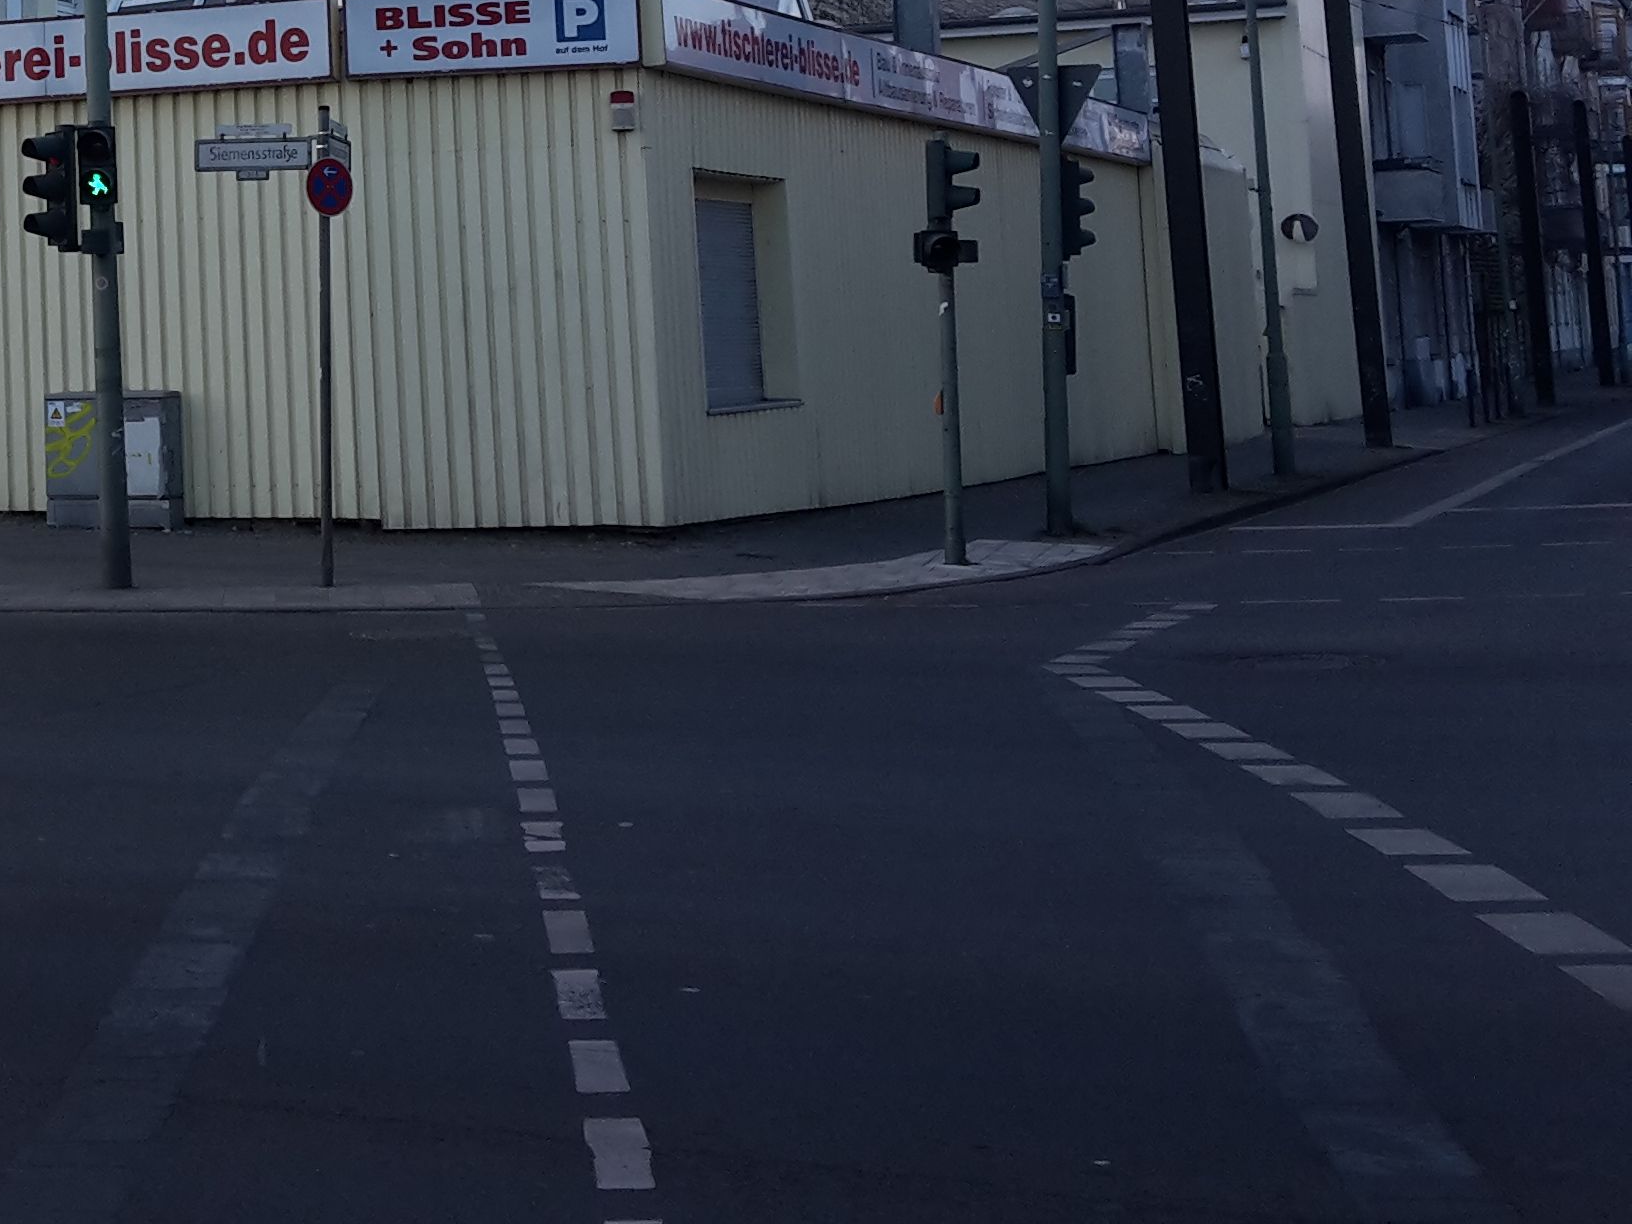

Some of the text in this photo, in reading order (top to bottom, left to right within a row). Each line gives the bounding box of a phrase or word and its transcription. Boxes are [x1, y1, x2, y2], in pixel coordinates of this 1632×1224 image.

[375, 0, 531, 31] BLISSE
[379, 32, 527, 61] + Sohn
[673, 15, 861, 87] www.tischlerei-blisse.de
[209, 143, 298, 163] Siemensstraße
